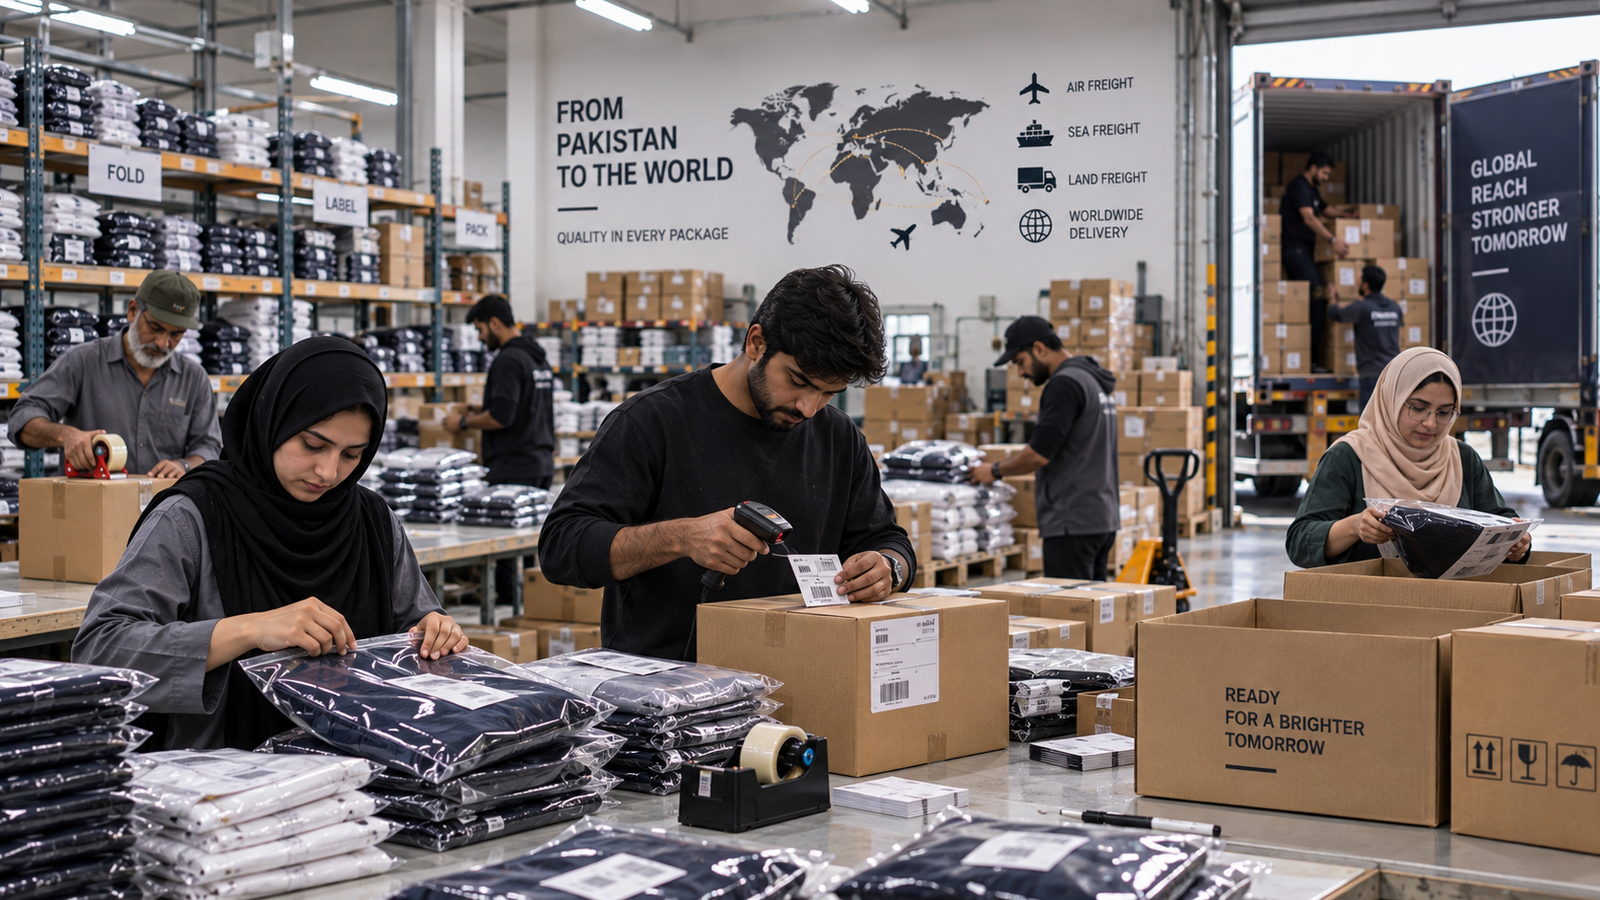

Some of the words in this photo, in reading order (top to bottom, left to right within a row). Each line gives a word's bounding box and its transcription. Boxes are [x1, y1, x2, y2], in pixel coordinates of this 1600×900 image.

[1066, 81, 1084, 92] AIR
[1087, 77, 1133, 91] FREIGHT
[557, 97, 622, 123] FROM
[1067, 126, 1089, 137] SEA
[1092, 122, 1140, 136] FREIGHT
[557, 126, 676, 156] PAKISTAN
[107, 164, 144, 183] FOLD
[557, 165, 586, 188] TO
[593, 162, 636, 186] THE
[644, 157, 733, 184] WORLD
[1470, 150, 1537, 178] GLOBAL
[1068, 174, 1098, 185] LAND
[1101, 171, 1147, 184] FREIGHT
[1471, 177, 1527, 204] REACH
[325, 197, 356, 213] LABEL
[1471, 198, 1559, 229] STRONGER
[1068, 209, 1143, 221] WORLDWIDE
[465, 223, 487, 236] PACK
[557, 231, 607, 245] QUALITY
[611, 231, 622, 242] IN
[626, 230, 665, 242] EVERY
[669, 227, 728, 240] PACKAGE
[1069, 226, 1128, 239] DELIVERY
[1471, 223, 1567, 254] TOMORROW
[1225, 688, 1280, 705] READY
[1225, 710, 1257, 726] FOR
[1262, 713, 1274, 728] A
[1279, 714, 1364, 736] BRIGHTER
[1224, 732, 1325, 755] TOMORROW
